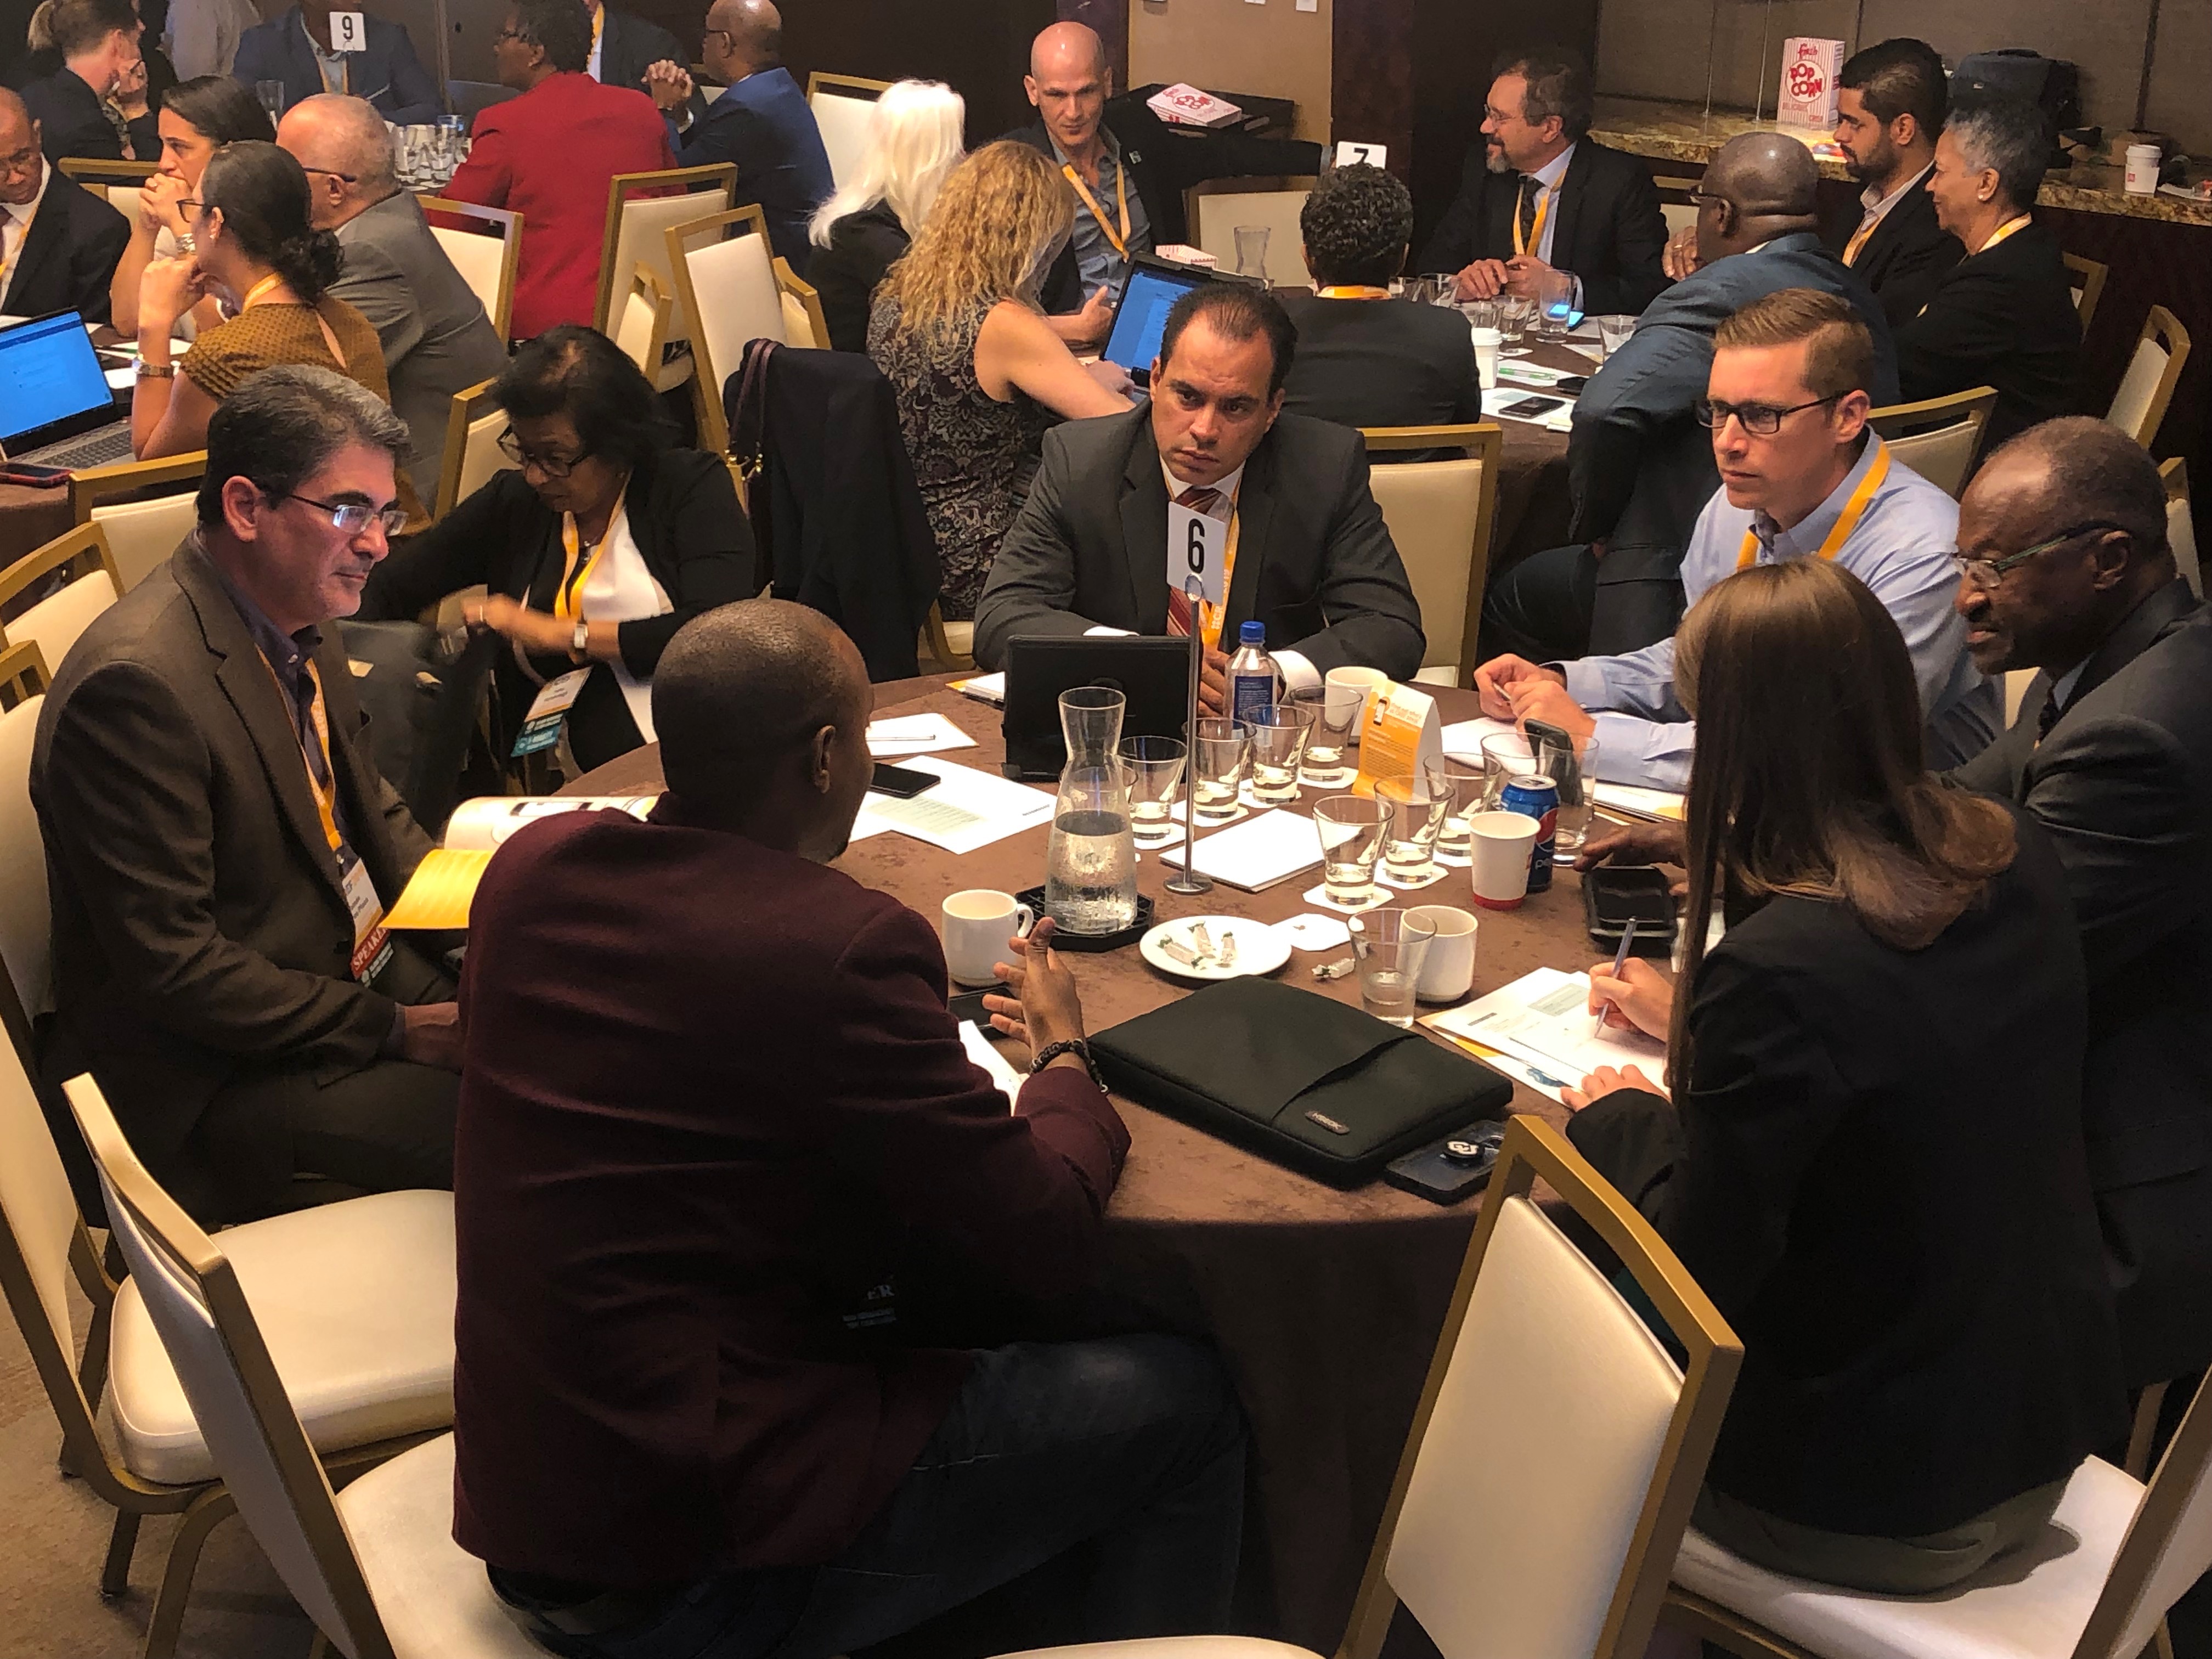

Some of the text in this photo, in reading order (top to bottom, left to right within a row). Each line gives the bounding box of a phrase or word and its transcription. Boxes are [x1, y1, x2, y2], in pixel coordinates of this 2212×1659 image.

[342, 15, 354, 40] 9
[1789, 63, 1815, 82] POP
[1791, 78, 1822, 97] CORN
[1353, 147, 1369, 166] 7
[1188, 518, 1205, 574] 6
